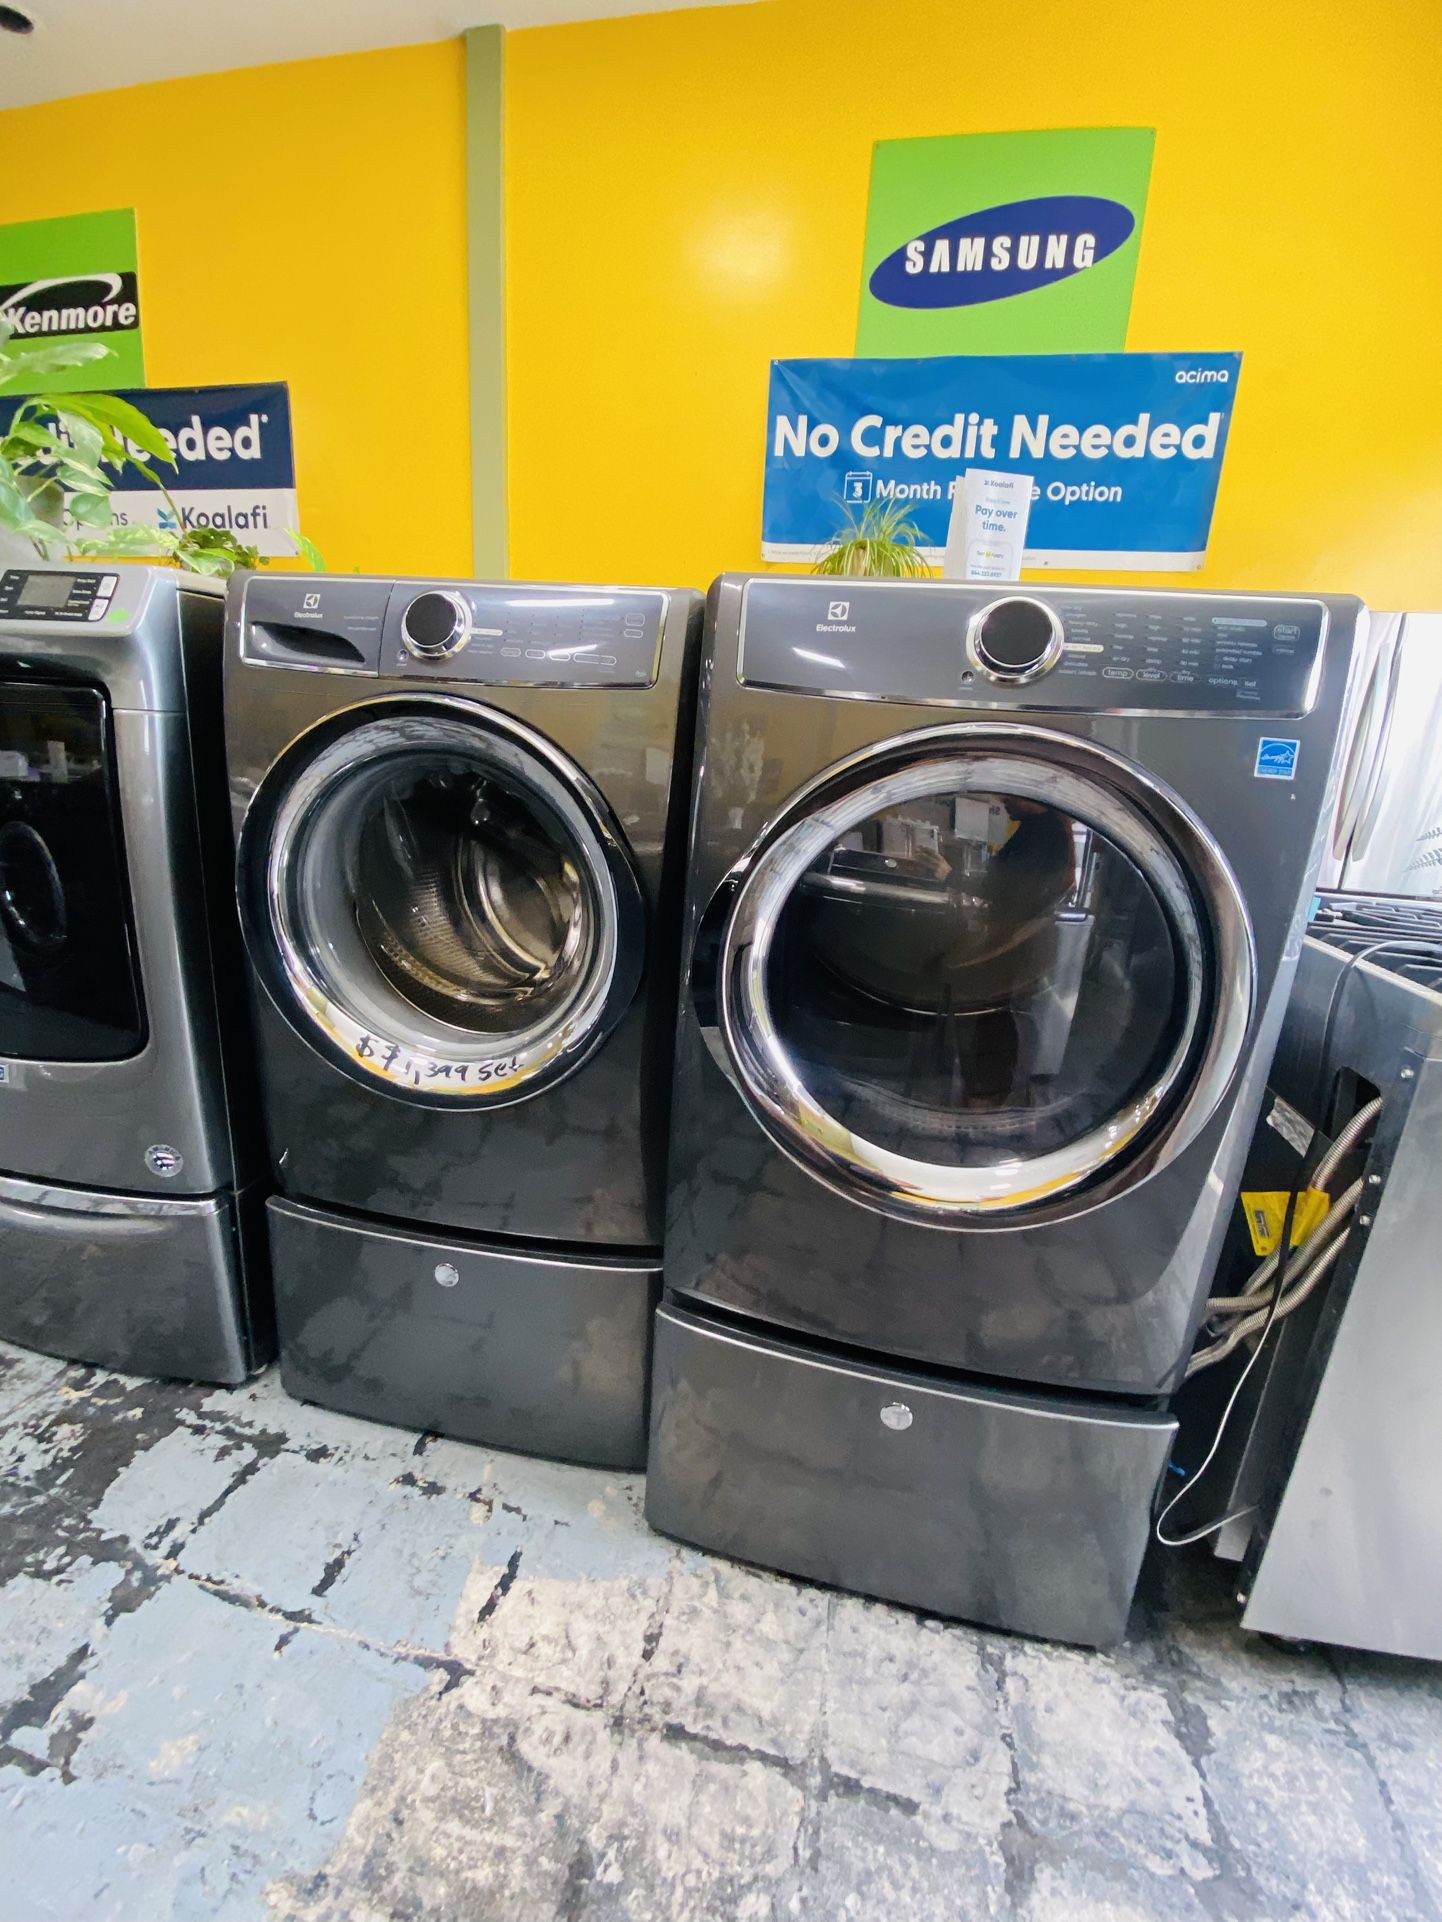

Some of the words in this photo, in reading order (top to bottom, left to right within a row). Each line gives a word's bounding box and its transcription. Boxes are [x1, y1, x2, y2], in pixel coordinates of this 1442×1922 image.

[905, 233, 1096, 274] SAMSUNG
[7, 302, 137, 333] Kenmore
[1175, 368, 1229, 383] acima
[774, 414, 839, 458] No
[851, 412, 998, 459] Credit
[876, 479, 941, 500] Month
[1046, 481, 1123, 505] Option
[180, 504, 269, 530] Koalafi
[975, 504, 994, 518] Pay
[996, 508, 1018, 519] over
[982, 520, 1006, 532] time.
[816, 623, 856, 633] Electrolux
[1107, 668, 1129, 679] temp
